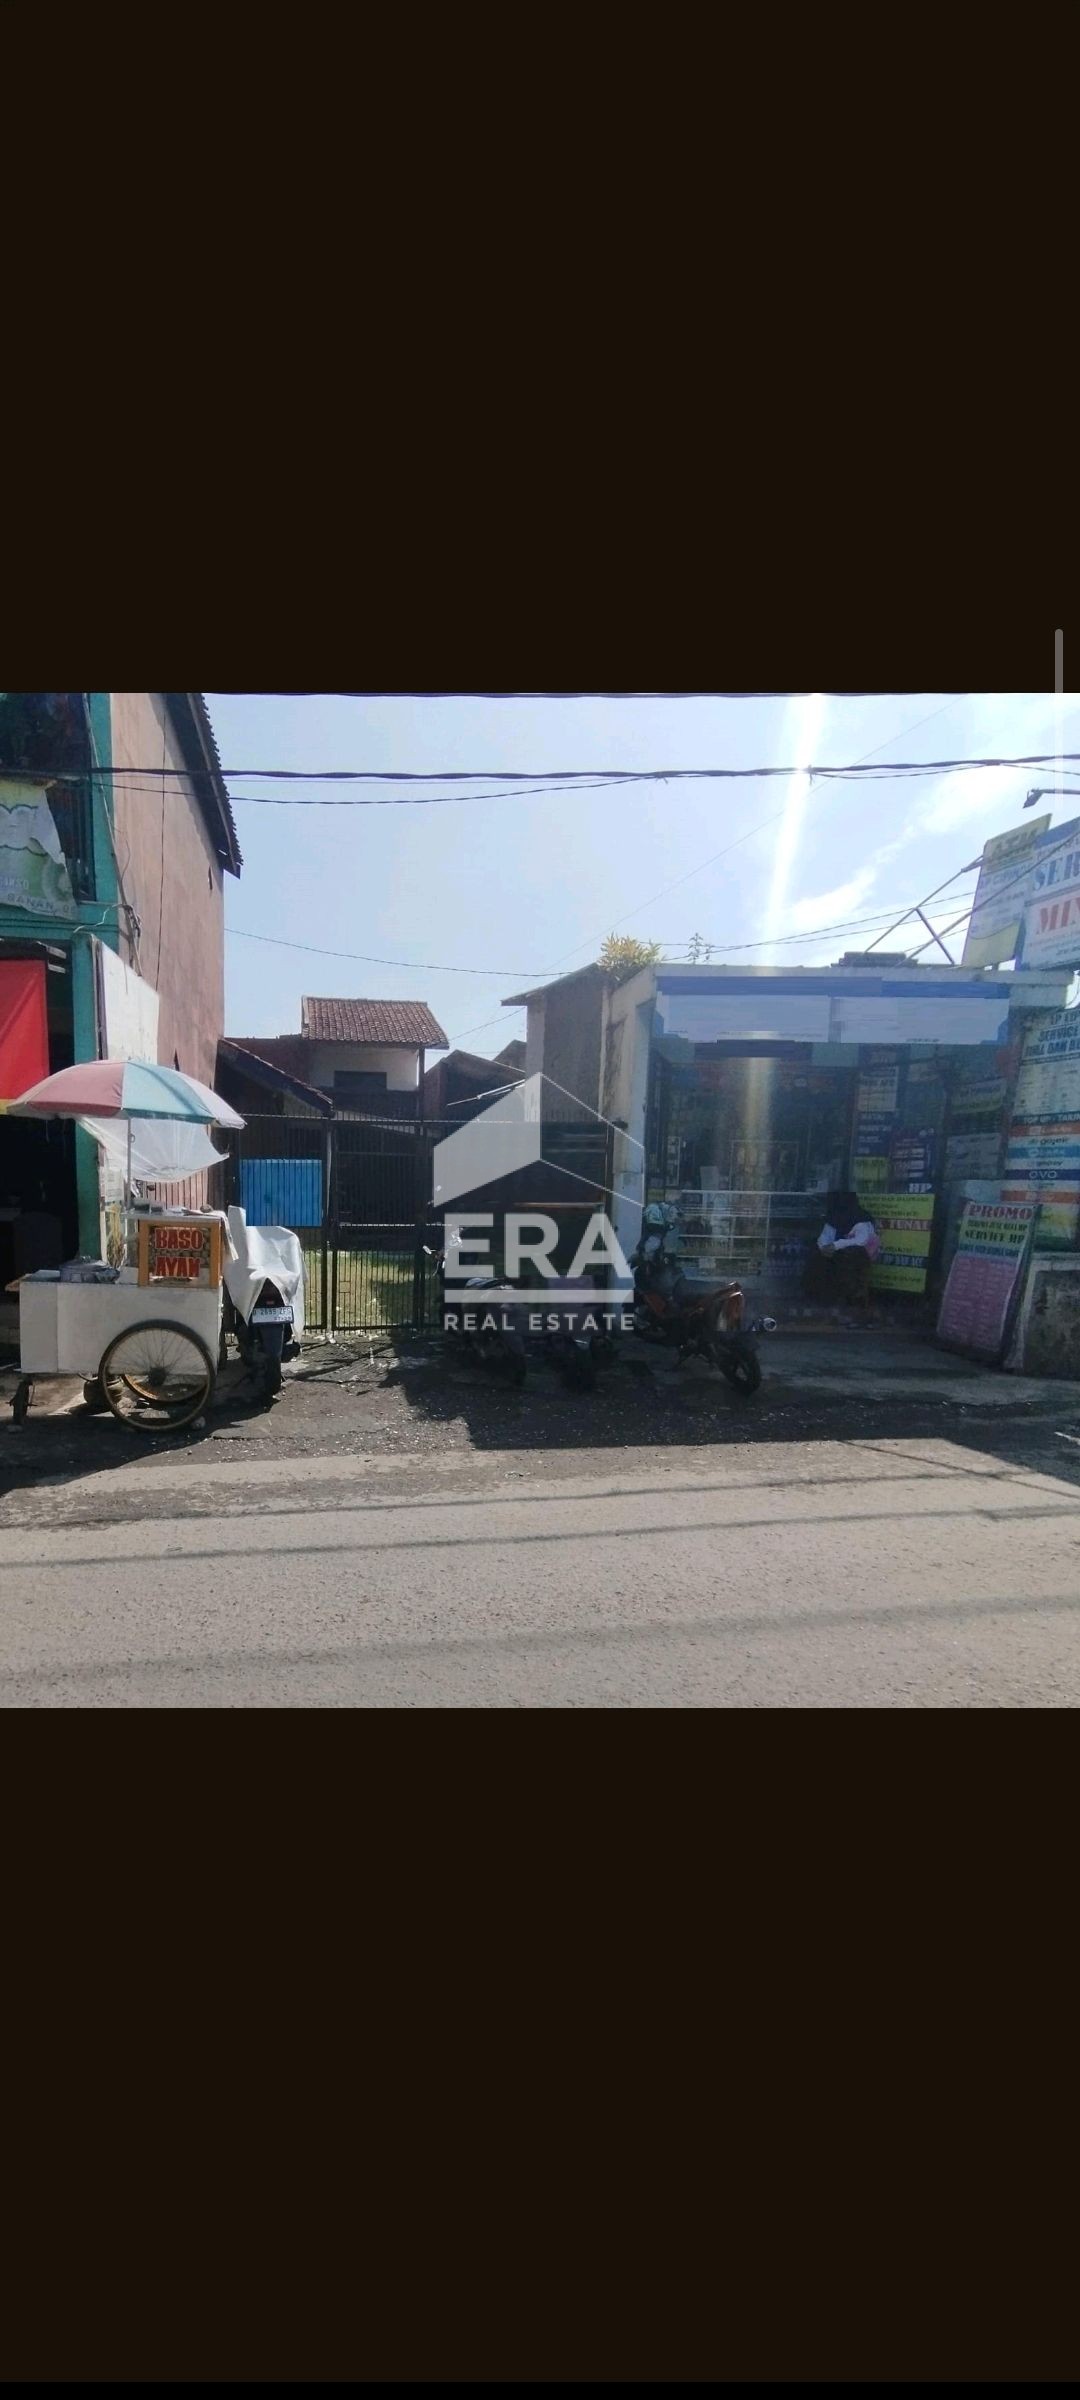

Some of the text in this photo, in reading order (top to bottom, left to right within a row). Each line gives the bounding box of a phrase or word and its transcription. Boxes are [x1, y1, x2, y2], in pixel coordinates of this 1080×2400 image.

[1029, 1170, 1057, 1179] OVO
[968, 1204, 1033, 1221] PROMO
[155, 1228, 203, 1250] BASO
[155, 1256, 200, 1278] AYAM
